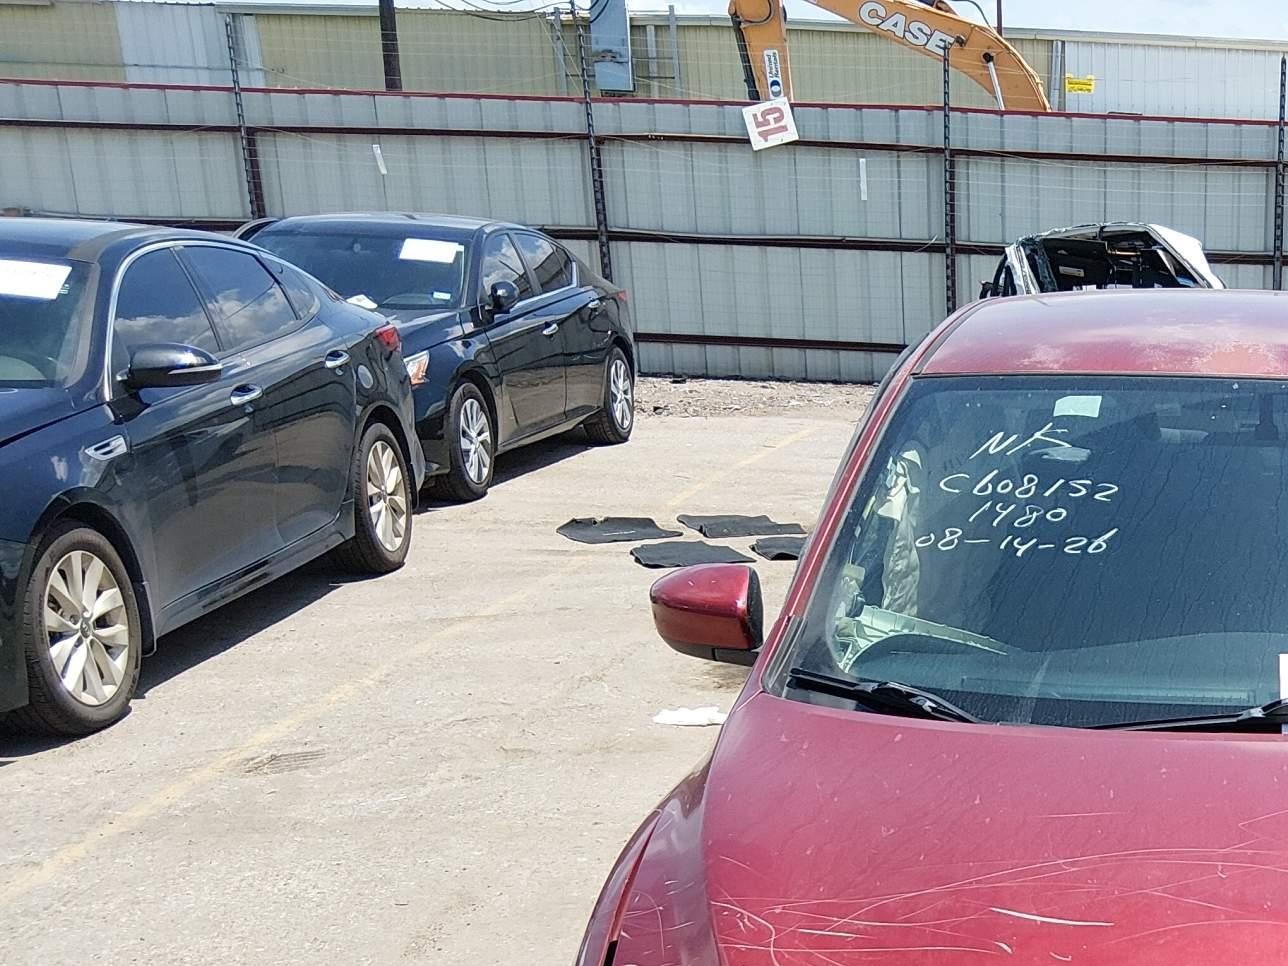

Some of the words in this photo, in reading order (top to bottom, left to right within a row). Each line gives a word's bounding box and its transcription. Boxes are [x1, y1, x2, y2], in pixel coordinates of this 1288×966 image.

[859, 1, 955, 57] CASE
[752, 106, 788, 142] 15
[969, 500, 1067, 528] 1480
